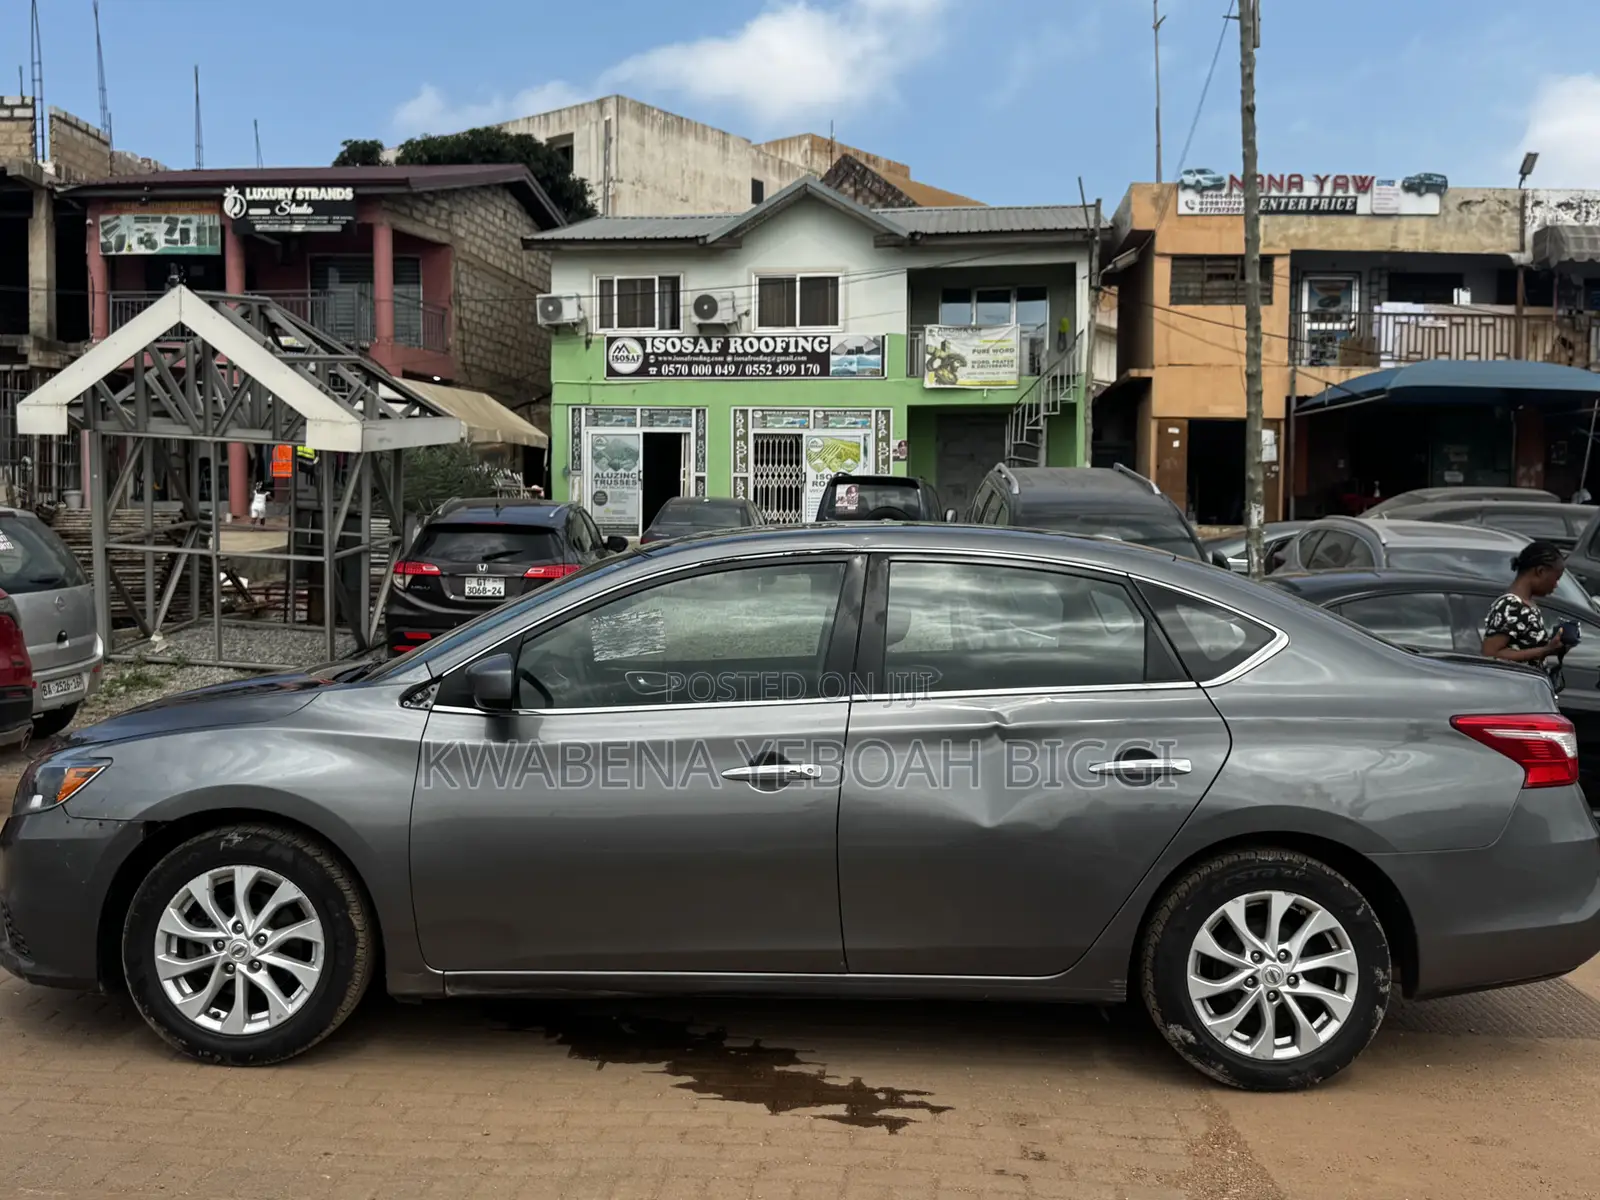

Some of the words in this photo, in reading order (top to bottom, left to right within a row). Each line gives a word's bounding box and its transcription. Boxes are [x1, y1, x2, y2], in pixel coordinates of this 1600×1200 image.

[1313, 174, 1376, 194] YAW
[245, 187, 295, 200] LUXURY
[295, 187, 354, 200] STRANDS
[274, 200, 314, 216] Studio
[644, 337, 725, 353] ISOSAF
[728, 336, 830, 354] ROOFING
[661, 363, 689, 376] 0570
[691, 363, 712, 376] 000
[714, 363, 736, 376] 049
[745, 363, 773, 376] 0552
[775, 363, 797, 376] 499
[800, 363, 821, 376] 170
[466, 586, 502, 596] 3068-24
